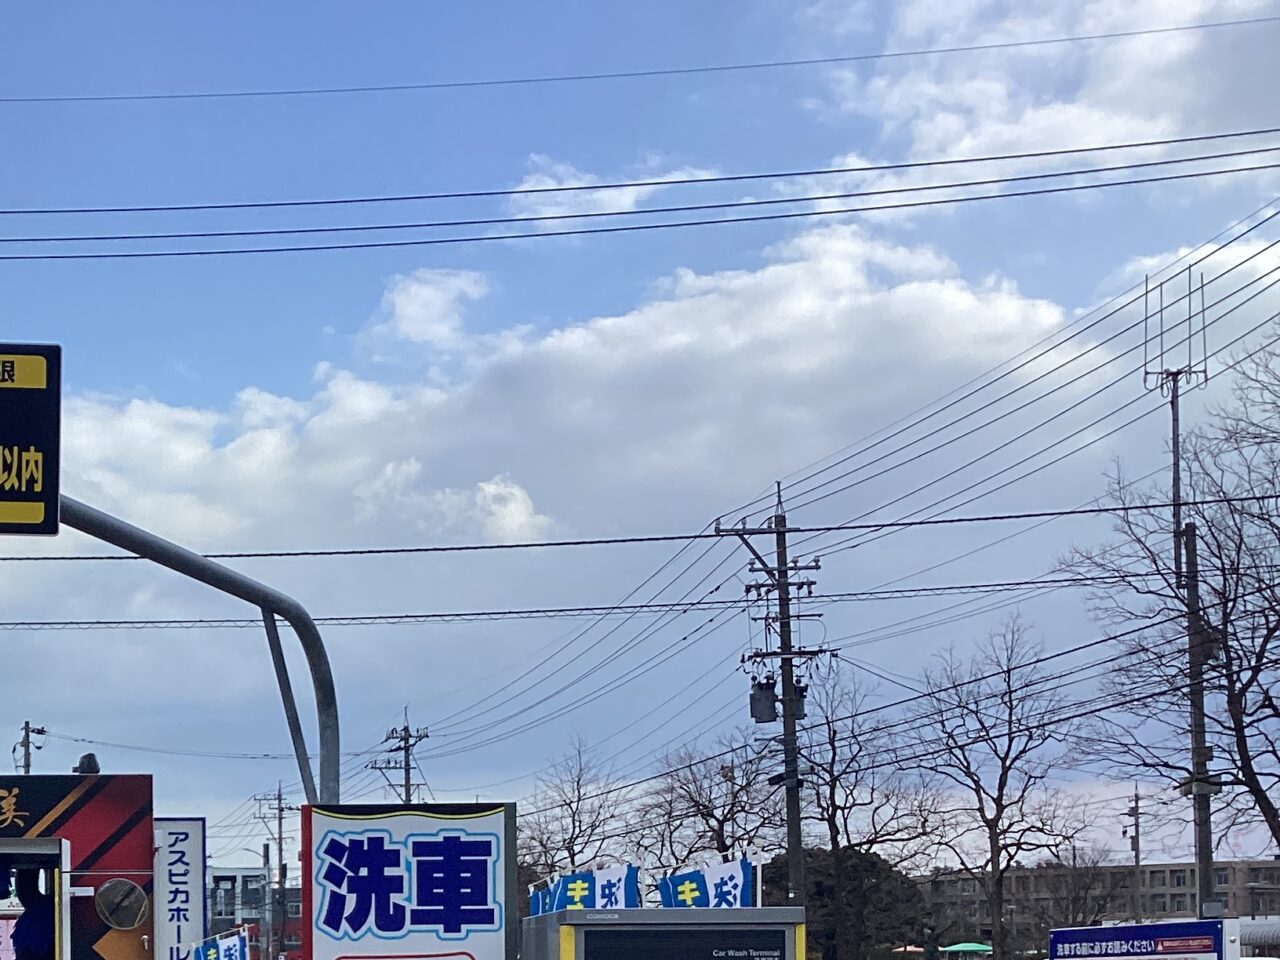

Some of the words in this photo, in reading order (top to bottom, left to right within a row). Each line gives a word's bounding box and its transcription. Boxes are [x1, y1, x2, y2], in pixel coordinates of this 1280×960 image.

[320, 832, 498, 937] 洗車
[712, 949, 726, 957] Car
[727, 949, 748, 957] Wash
[748, 949, 780, 957] Terminal
